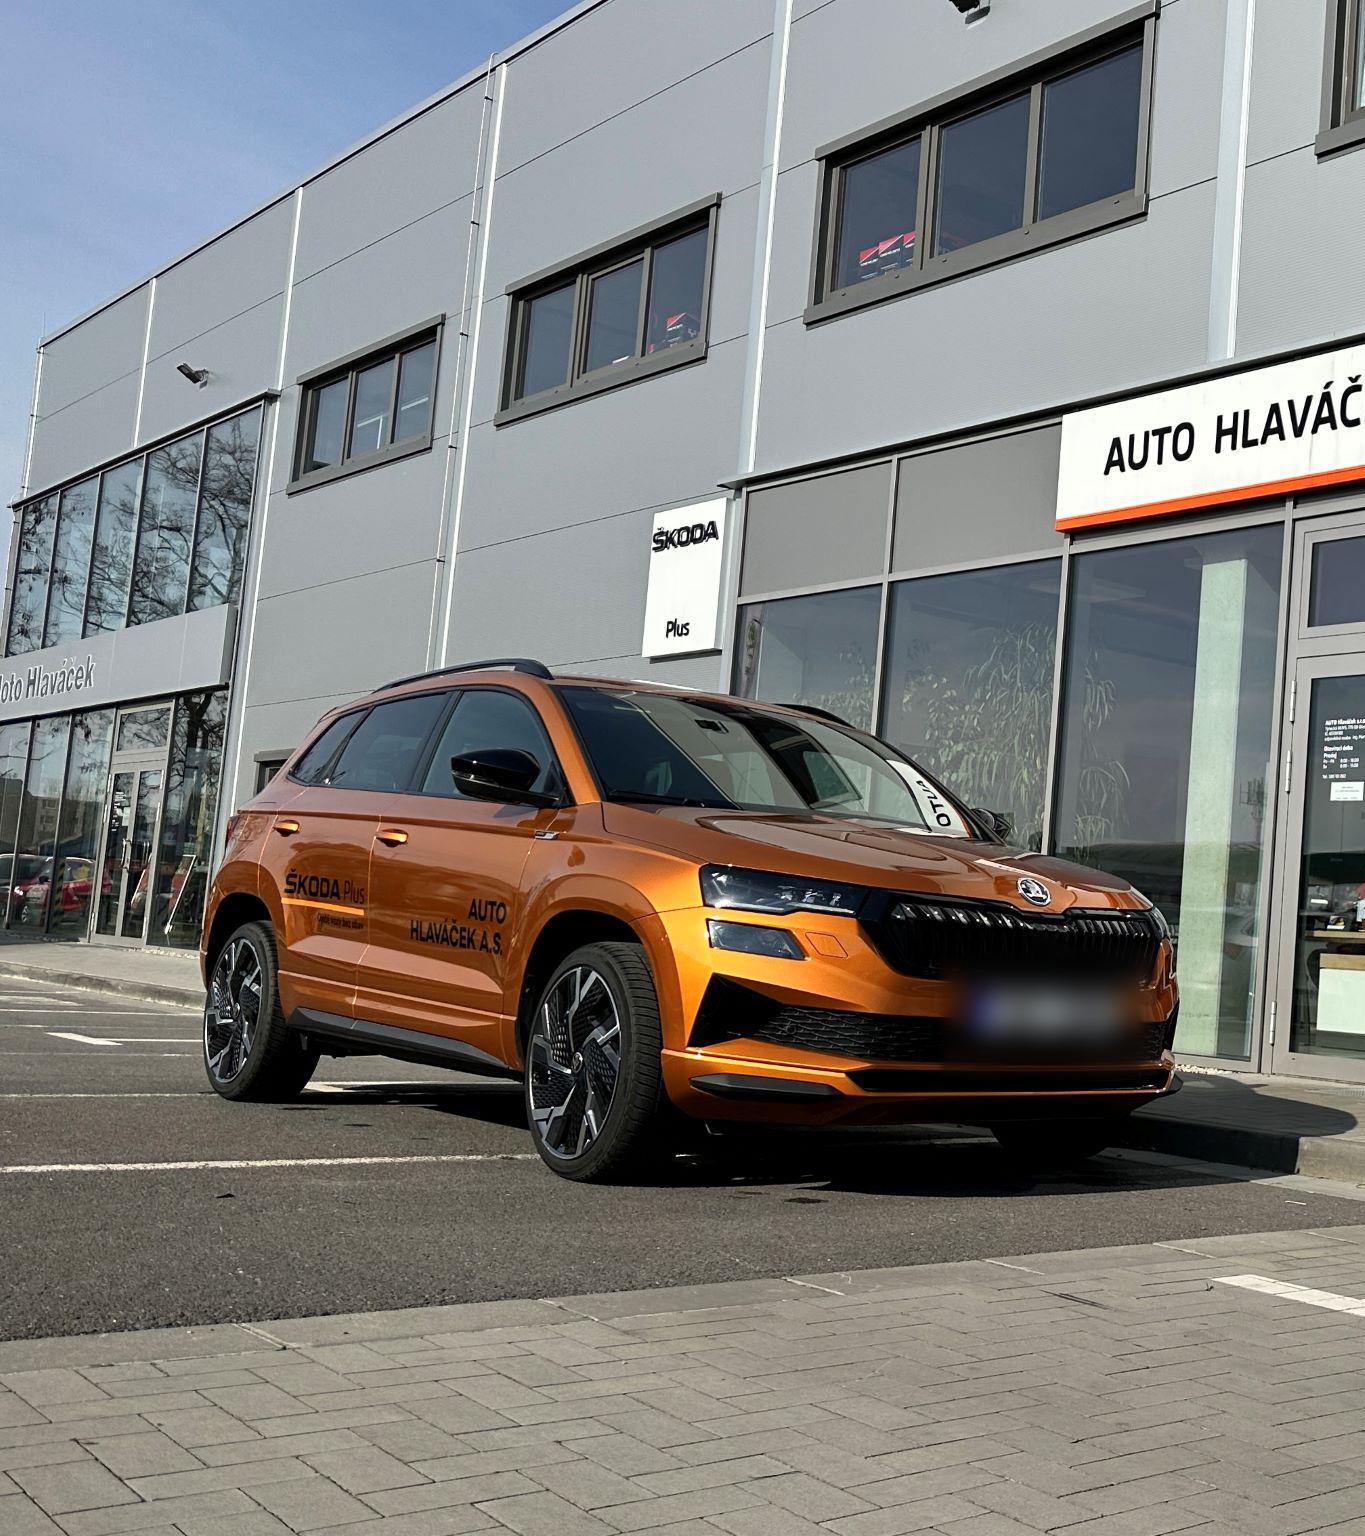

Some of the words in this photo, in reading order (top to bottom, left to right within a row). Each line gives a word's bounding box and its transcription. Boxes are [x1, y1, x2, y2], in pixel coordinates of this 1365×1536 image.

[1103, 421, 1195, 476] AUTO
[652, 520, 719, 553] ŠKODA
[665, 618, 690, 639] Plus
[26, 654, 96, 700] Hlaváček
[284, 867, 340, 900] ŠKODA
[344, 879, 365, 905] Plus
[468, 898, 507, 924] AUTO
[410, 915, 476, 950] HLAVÁČEK
[479, 930, 503, 956] A.S.
